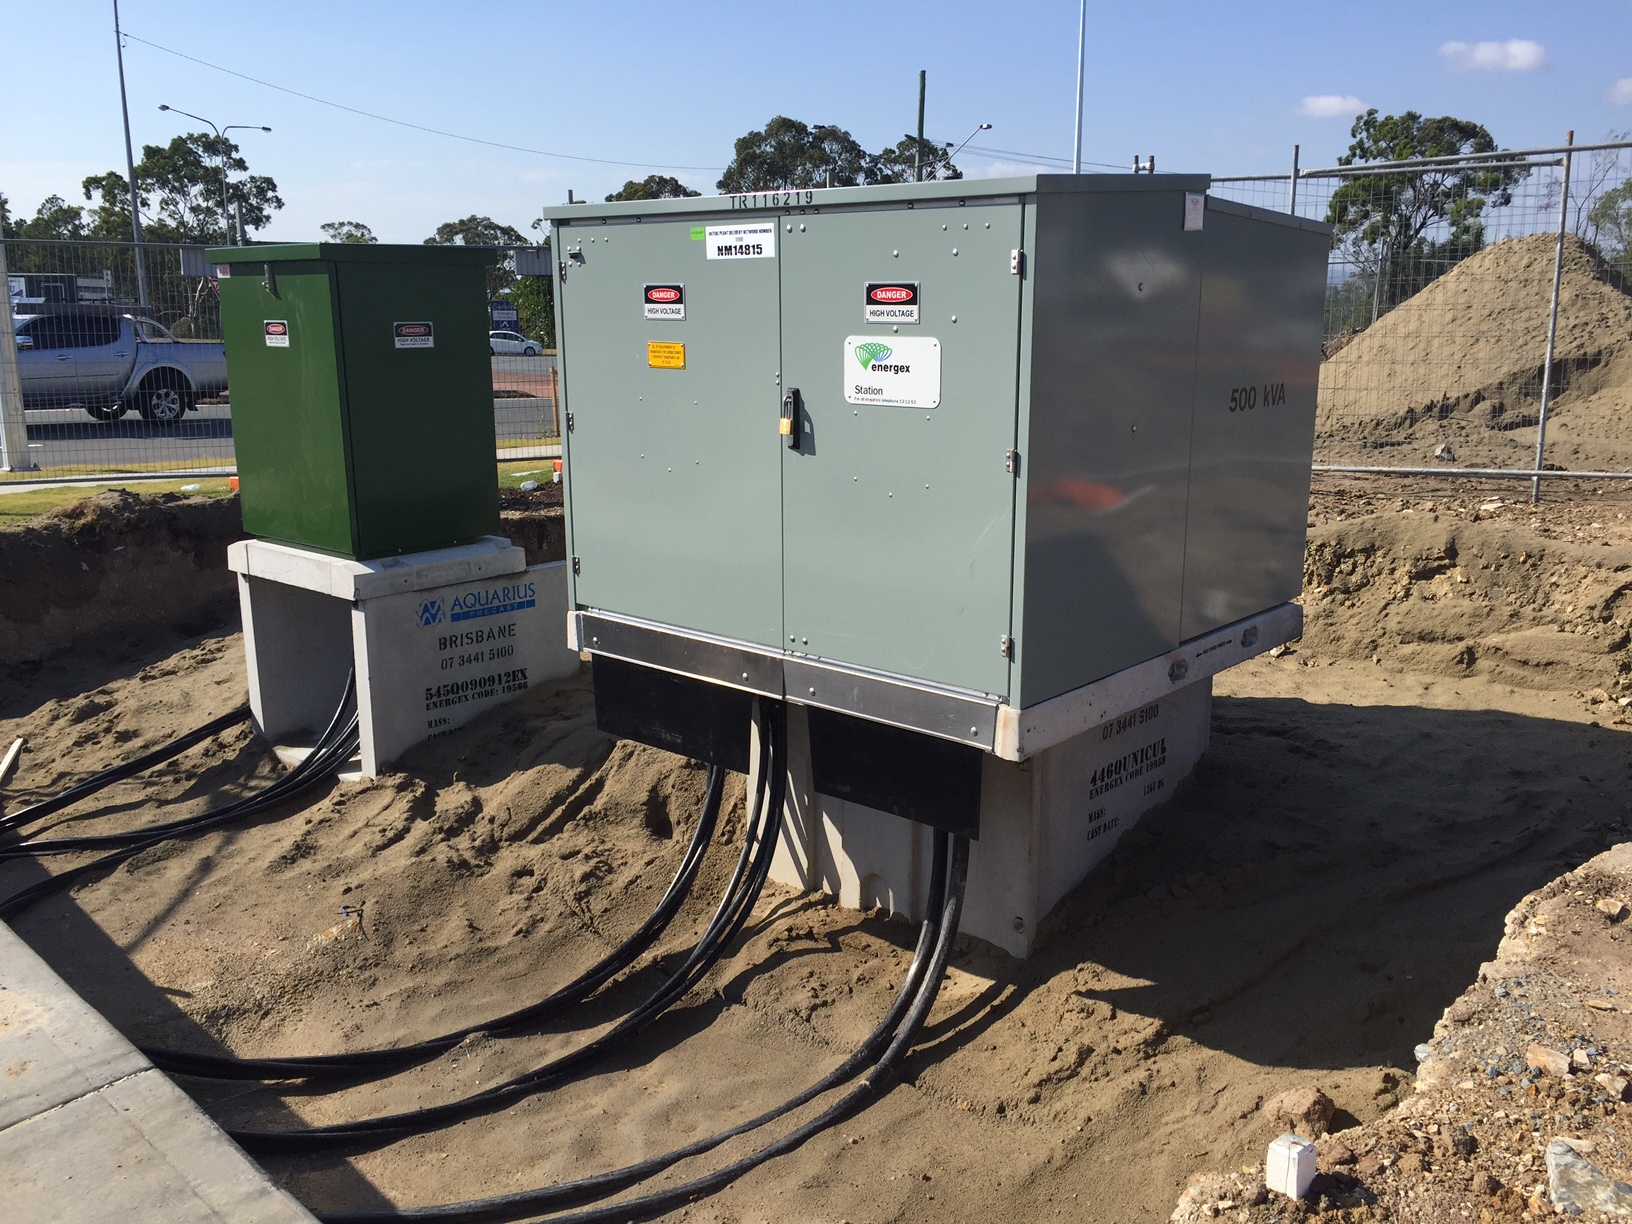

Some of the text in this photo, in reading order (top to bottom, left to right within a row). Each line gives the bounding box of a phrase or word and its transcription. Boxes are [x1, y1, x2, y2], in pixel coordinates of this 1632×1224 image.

[729, 191, 813, 209] TR116219
[717, 244, 763, 256] NM14815
[652, 291, 675, 299] DANGER
[876, 291, 907, 299] DANGER
[647, 307, 682, 315] HIGH VOLTAGE
[869, 309, 914, 318] HIGH VOLTAGE
[871, 363, 911, 375] energex
[854, 384, 883, 395] Station
[1229, 383, 1285, 412] 500 kVA
[450, 582, 536, 612] AQUARIUS
[469, 603, 519, 618] PRECAST
[438, 623, 516, 651] BRISBANE
[441, 645, 514, 670] 07 3441 5100
[425, 668, 528, 701] 545Q090912EX
[426, 681, 528, 711] ENERGEX CODE: 19566
[427, 717, 450, 729] MASS:
[1102, 704, 1159, 740] 07 3441 5100
[1090, 738, 1167, 788] 446QUNICUL
[1089, 776, 1124, 800] ENERGEX
[1088, 807, 1106, 824] MASS:
[1086, 824, 1103, 841] CAST
